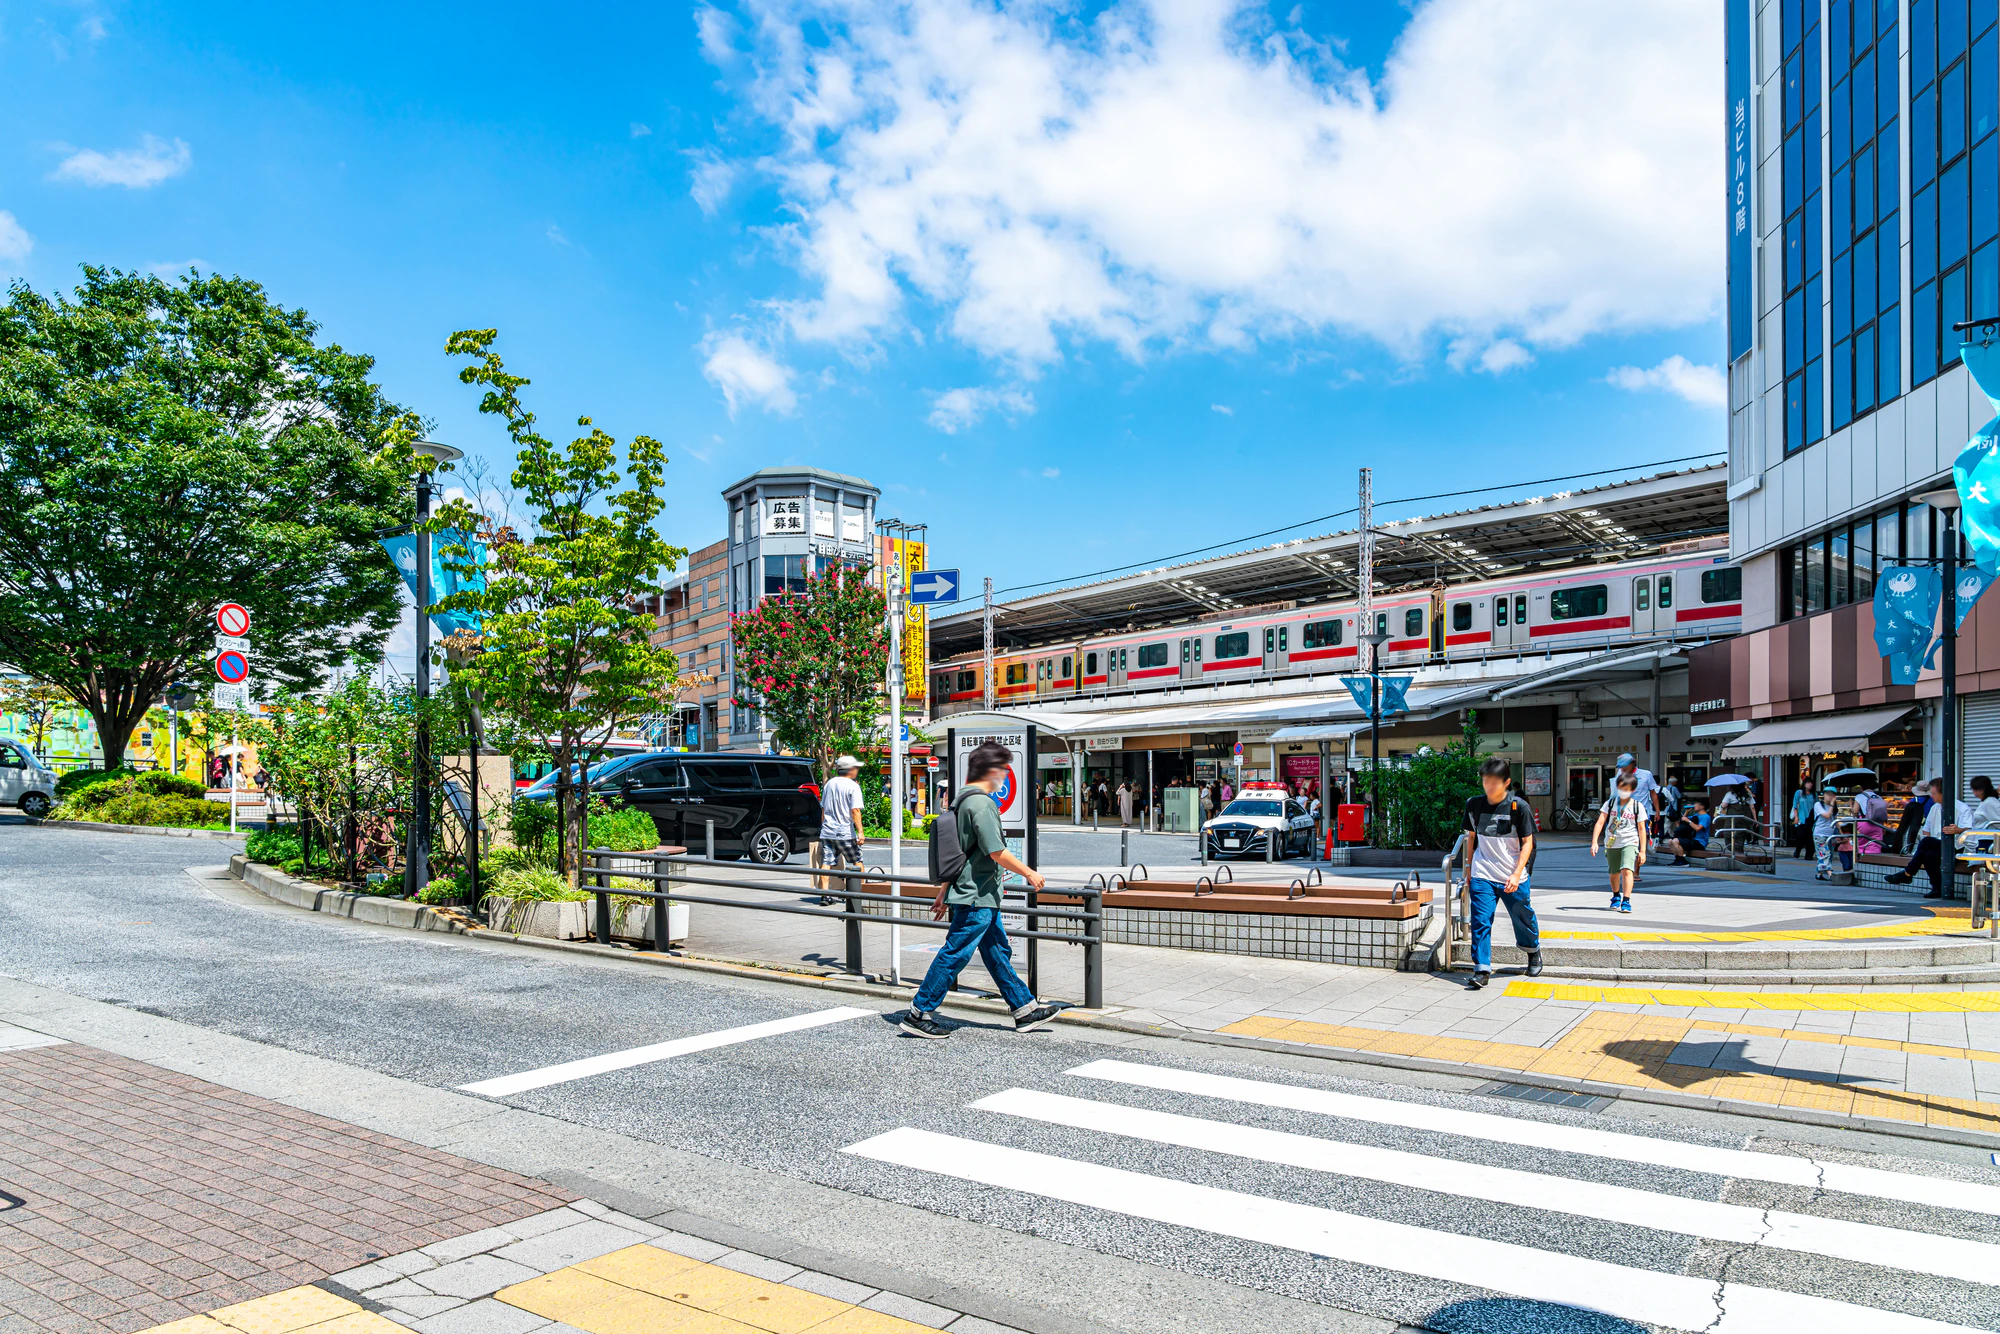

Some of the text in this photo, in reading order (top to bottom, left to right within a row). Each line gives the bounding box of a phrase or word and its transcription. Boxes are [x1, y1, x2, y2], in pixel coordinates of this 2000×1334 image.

[1735, 98, 1746, 236] 当ビル8階
[773, 502, 801, 514] 広告
[774, 516, 801, 529] 募集
[1097, 737, 1120, 746] 自由が丘駅
